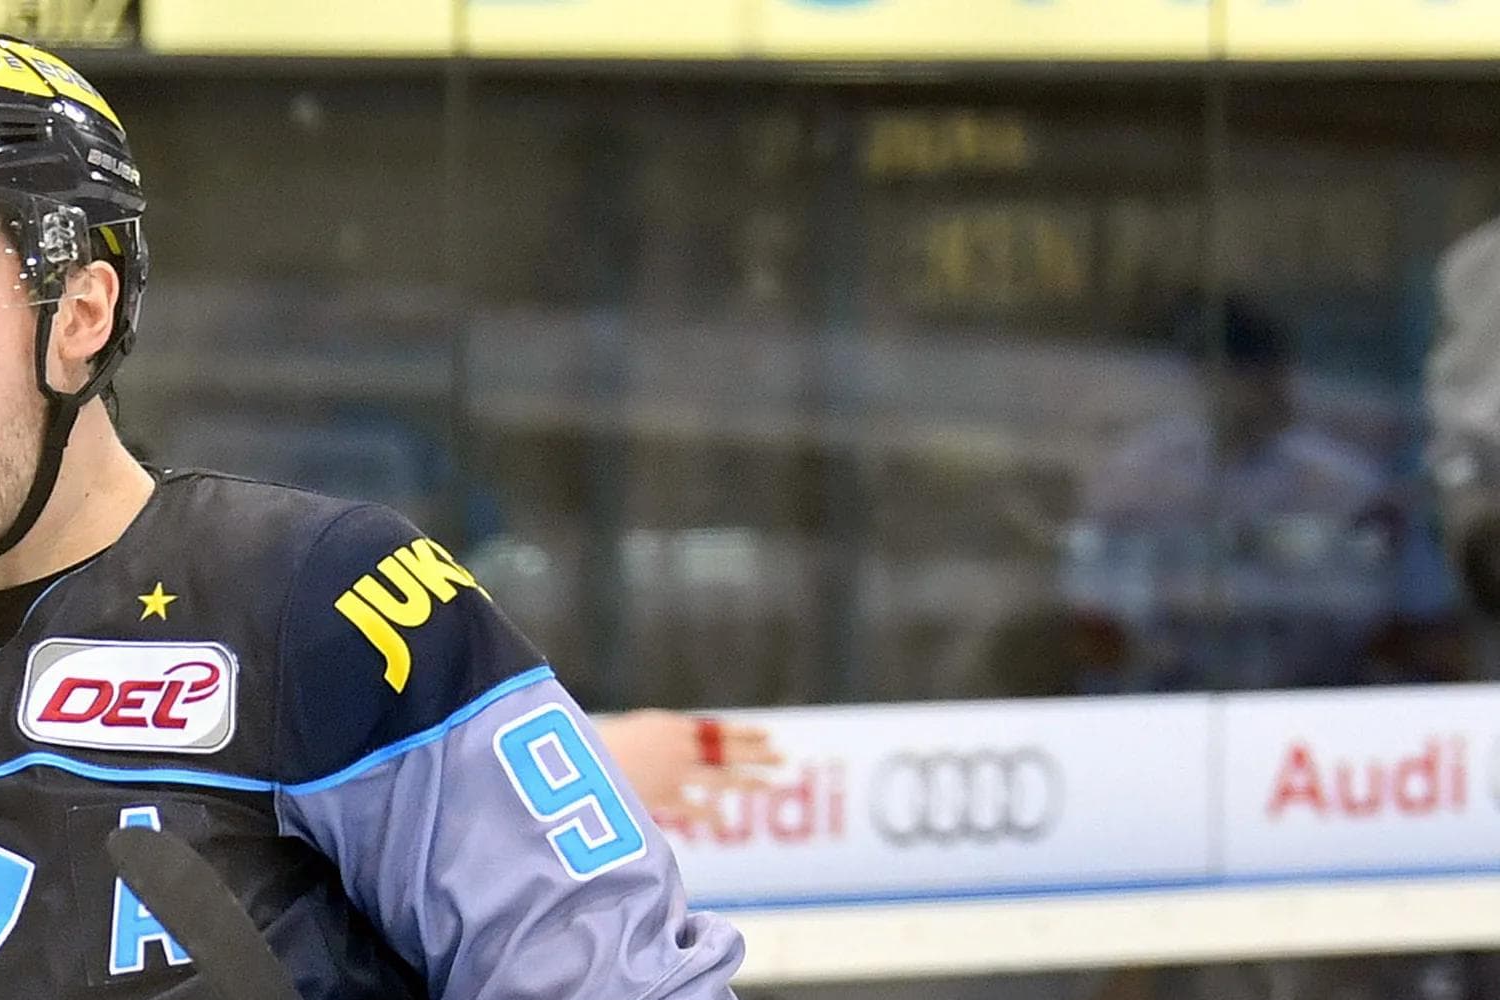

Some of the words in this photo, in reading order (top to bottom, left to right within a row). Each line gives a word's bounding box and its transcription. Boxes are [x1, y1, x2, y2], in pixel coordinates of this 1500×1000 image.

[334, 538, 490, 693] JUK
[36, 670, 198, 730] DEL
[1267, 735, 1468, 819] Audi
[493, 702, 647, 881] 9
[109, 806, 193, 975] A
